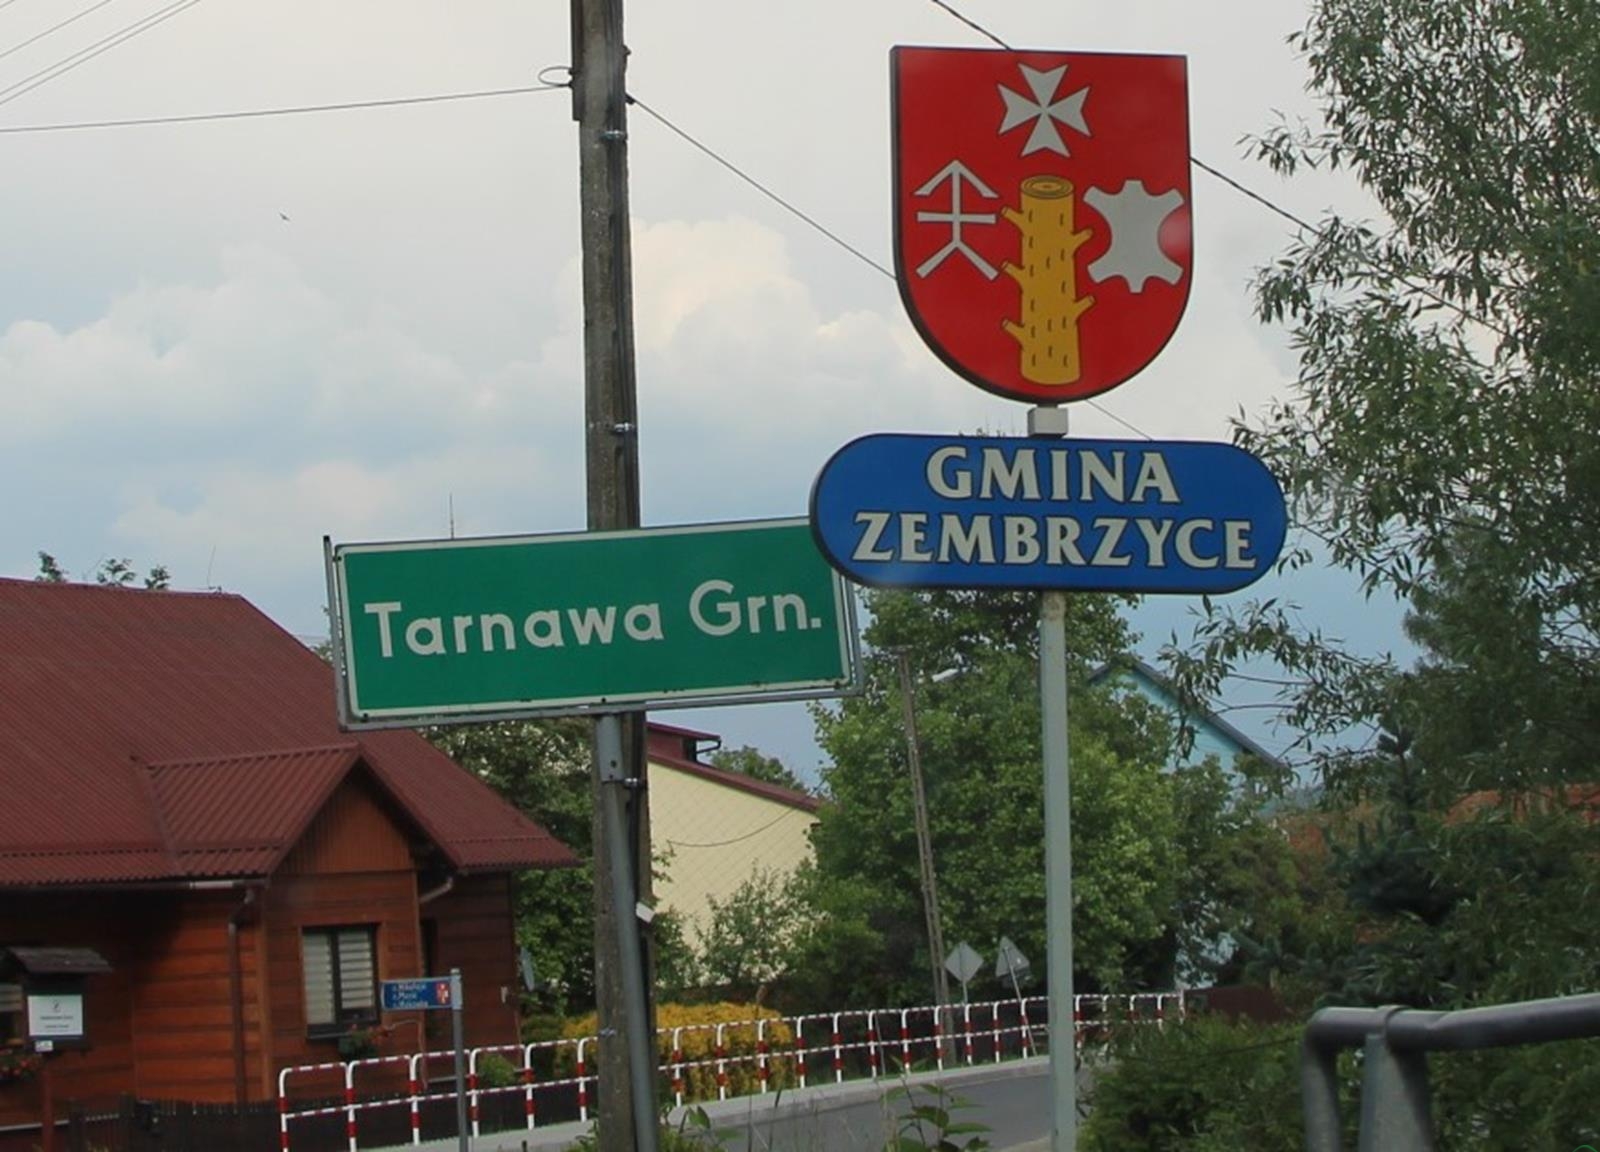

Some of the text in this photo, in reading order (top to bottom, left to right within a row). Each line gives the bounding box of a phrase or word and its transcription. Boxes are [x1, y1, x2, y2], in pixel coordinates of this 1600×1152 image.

[926, 446, 1181, 503] GMINA
[851, 511, 1257, 569] ZEMBRZYCE
[364, 579, 823, 658] Tarnawa Grn.
